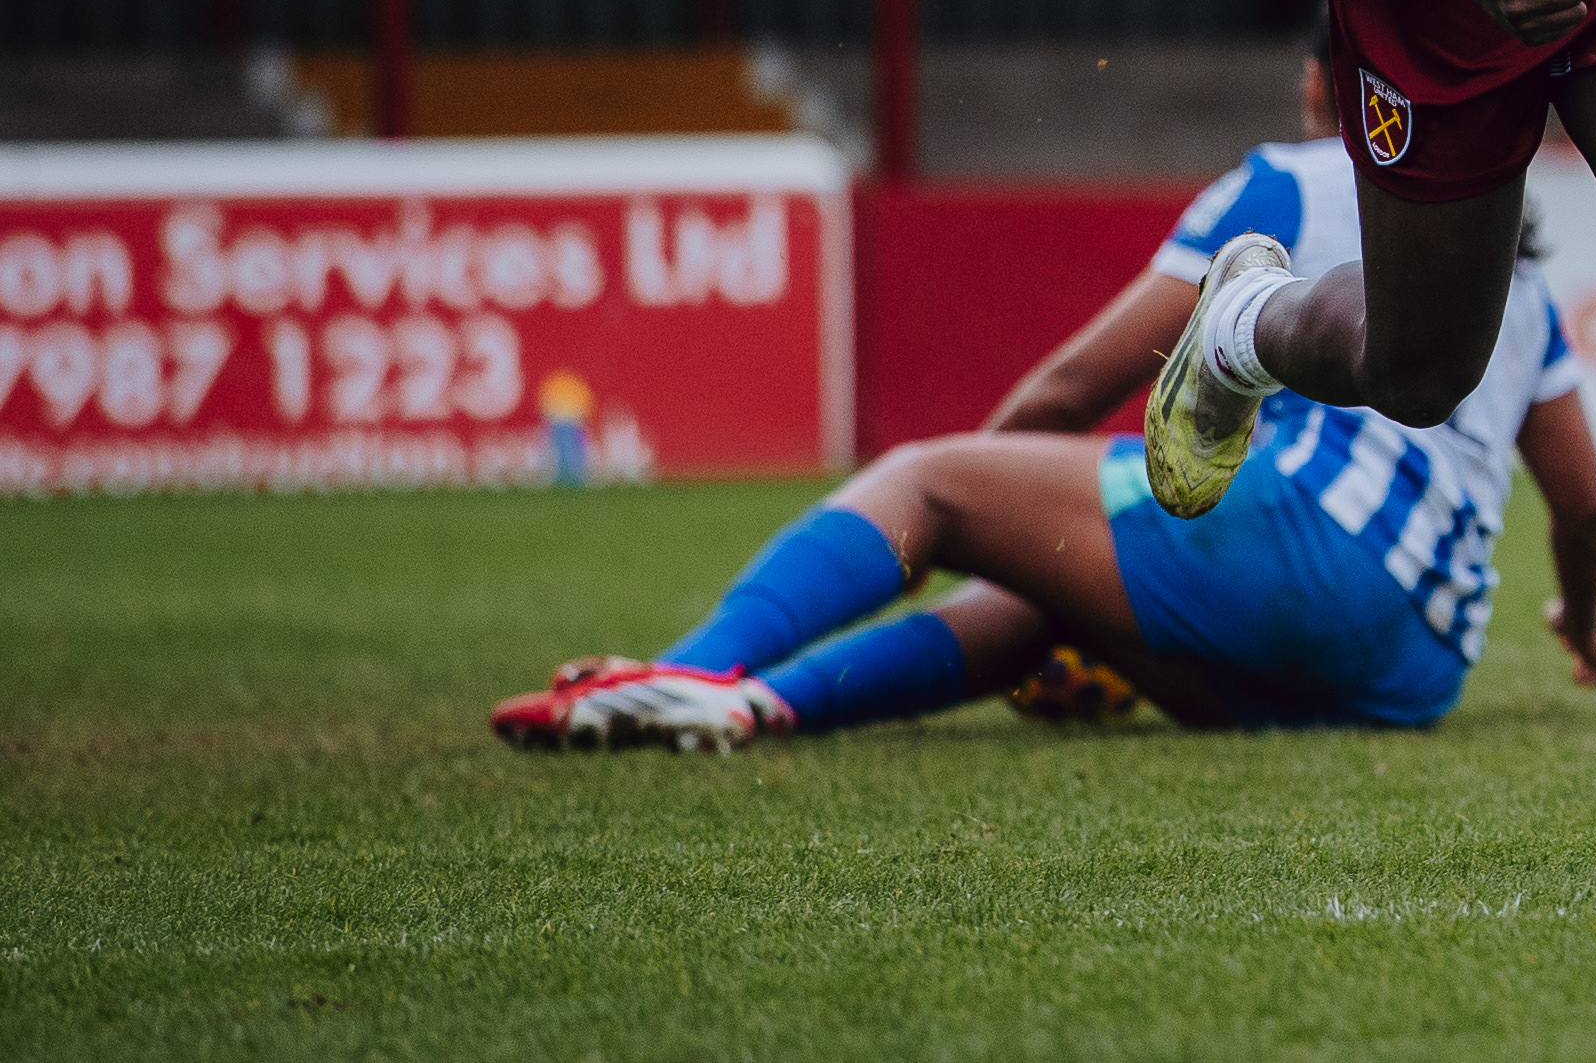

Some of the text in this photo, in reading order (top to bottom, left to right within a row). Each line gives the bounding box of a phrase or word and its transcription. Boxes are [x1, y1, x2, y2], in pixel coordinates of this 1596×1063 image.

[1365, 74, 1386, 92] WEST
[162, 198, 602, 314] Services
[627, 194, 786, 305] Ltd
[266, 314, 524, 422] 1223
